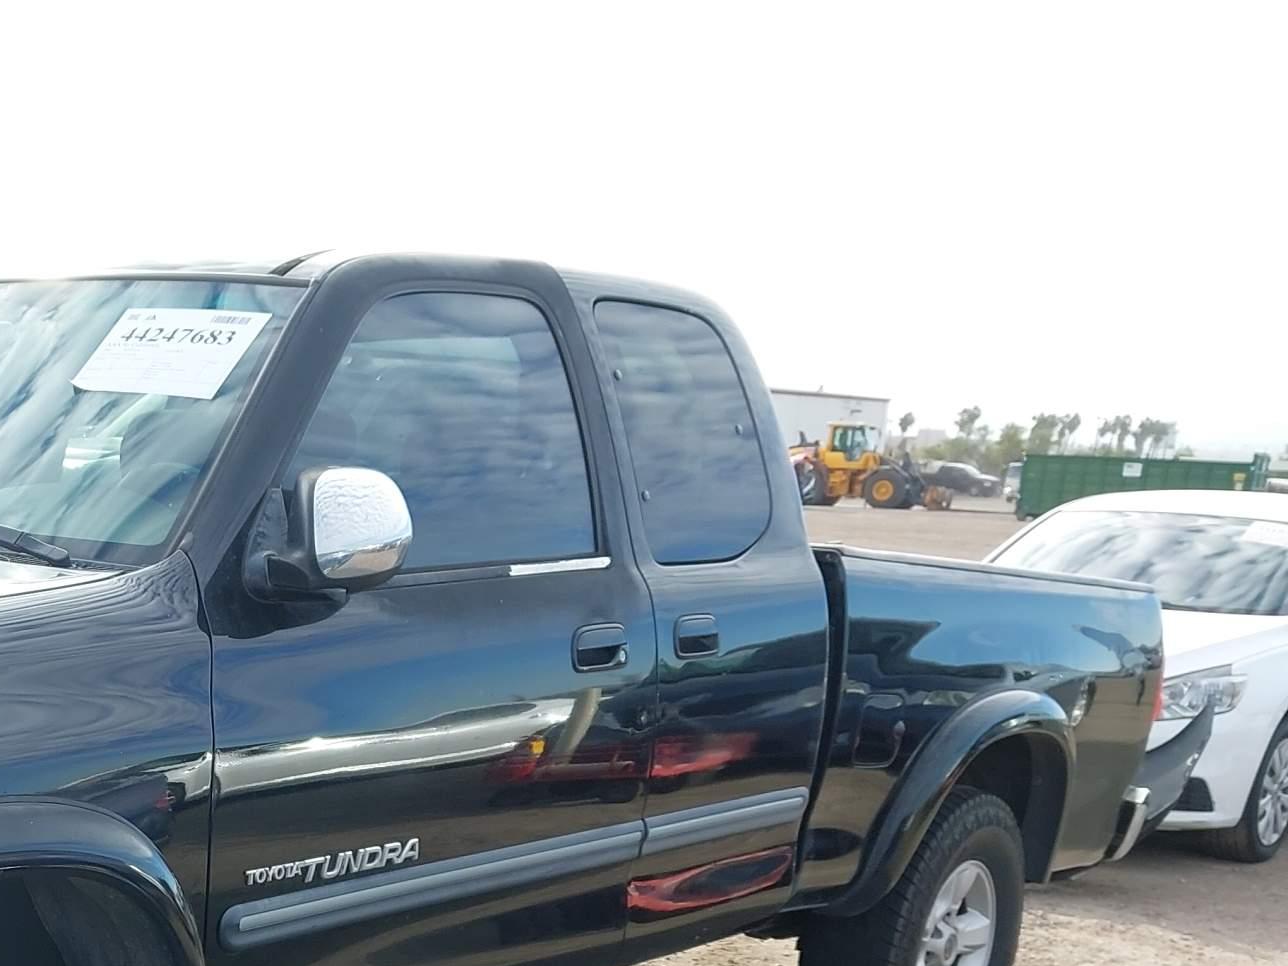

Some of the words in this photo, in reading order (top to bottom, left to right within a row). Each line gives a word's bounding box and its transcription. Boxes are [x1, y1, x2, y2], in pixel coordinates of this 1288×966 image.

[120, 327, 237, 346] 44247683
[245, 861, 305, 886] TOYOTA
[304, 838, 420, 884] TUNDRA
